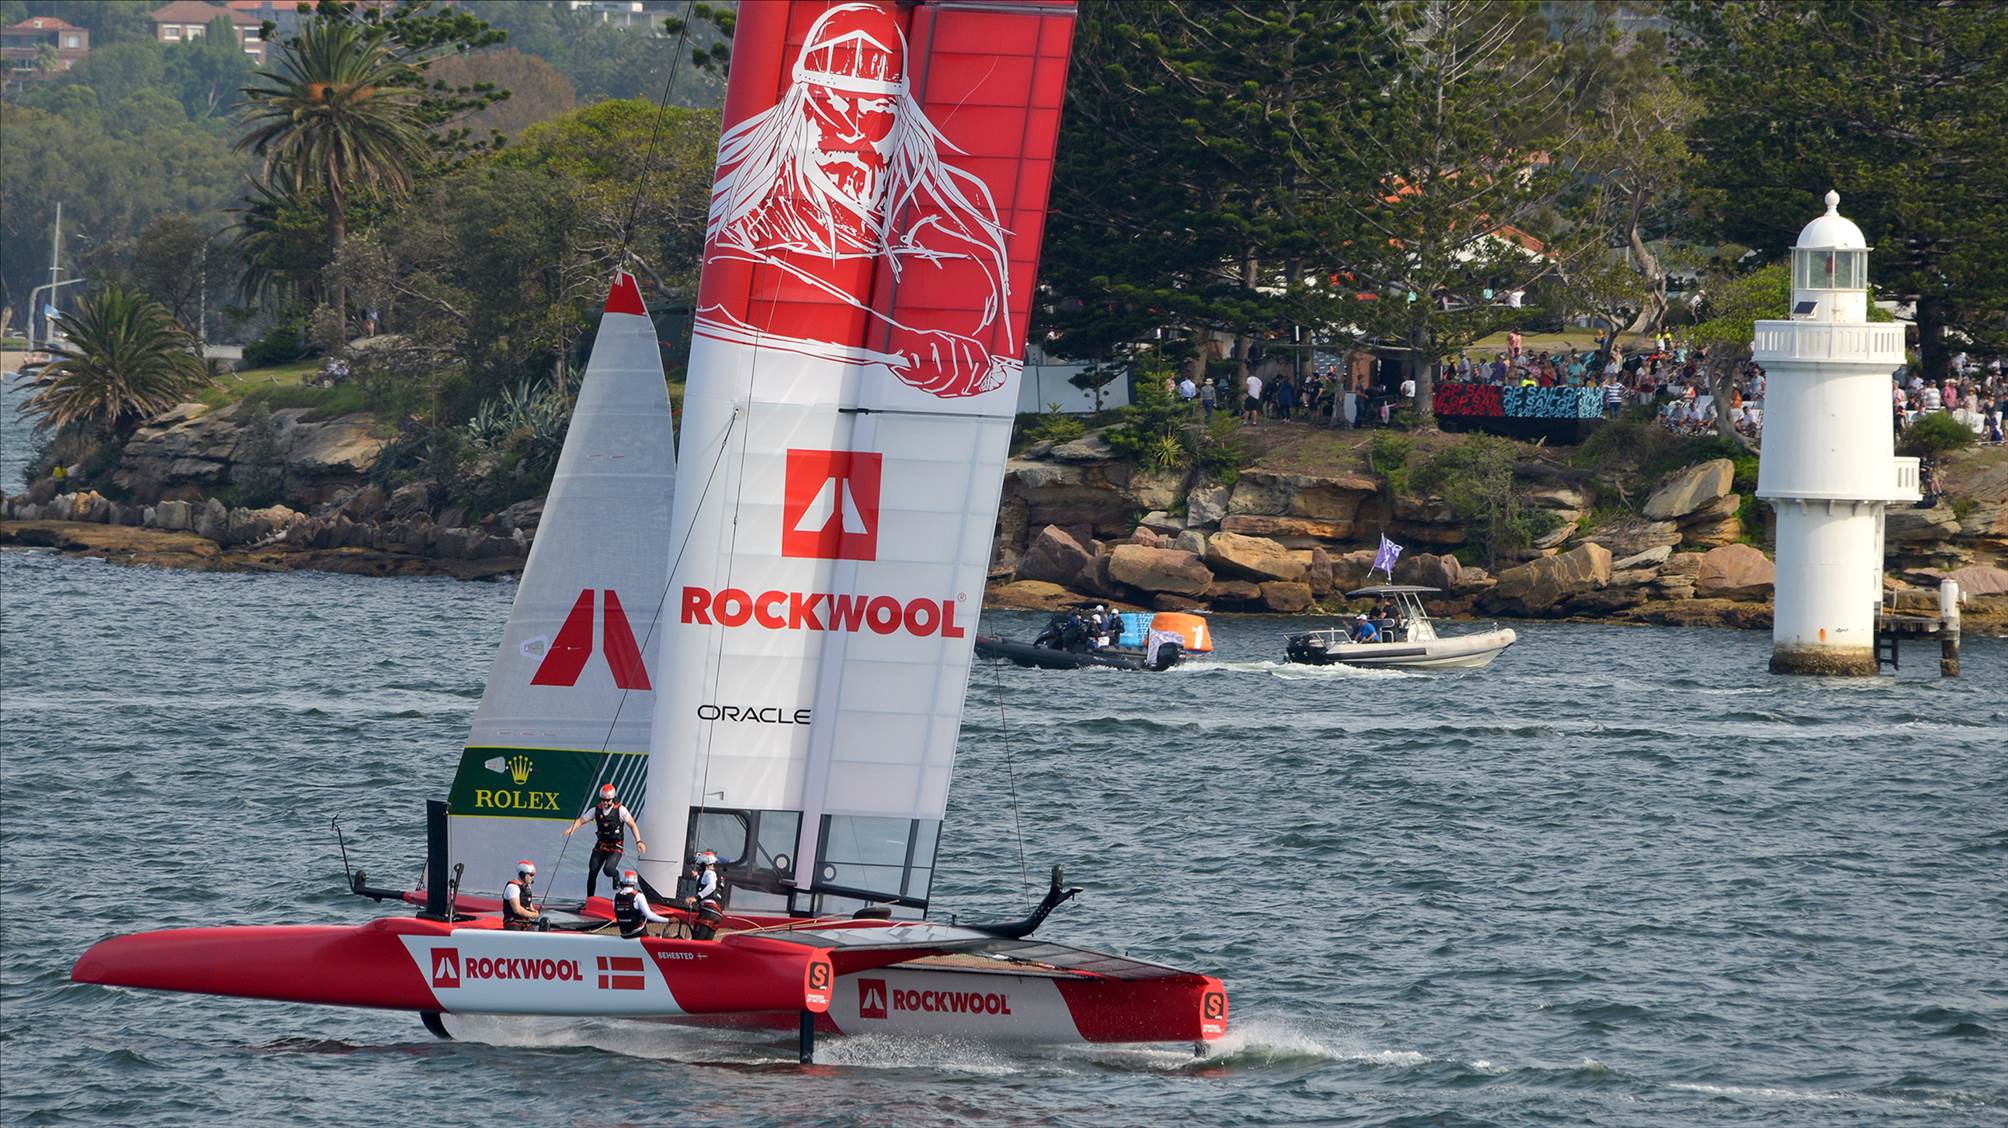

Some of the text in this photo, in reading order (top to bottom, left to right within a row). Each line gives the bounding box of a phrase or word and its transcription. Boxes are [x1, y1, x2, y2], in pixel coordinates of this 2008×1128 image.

[1191, 624, 1204, 649] 1
[697, 704, 812, 725] ORACLE
[474, 789, 560, 811] ROLEX
